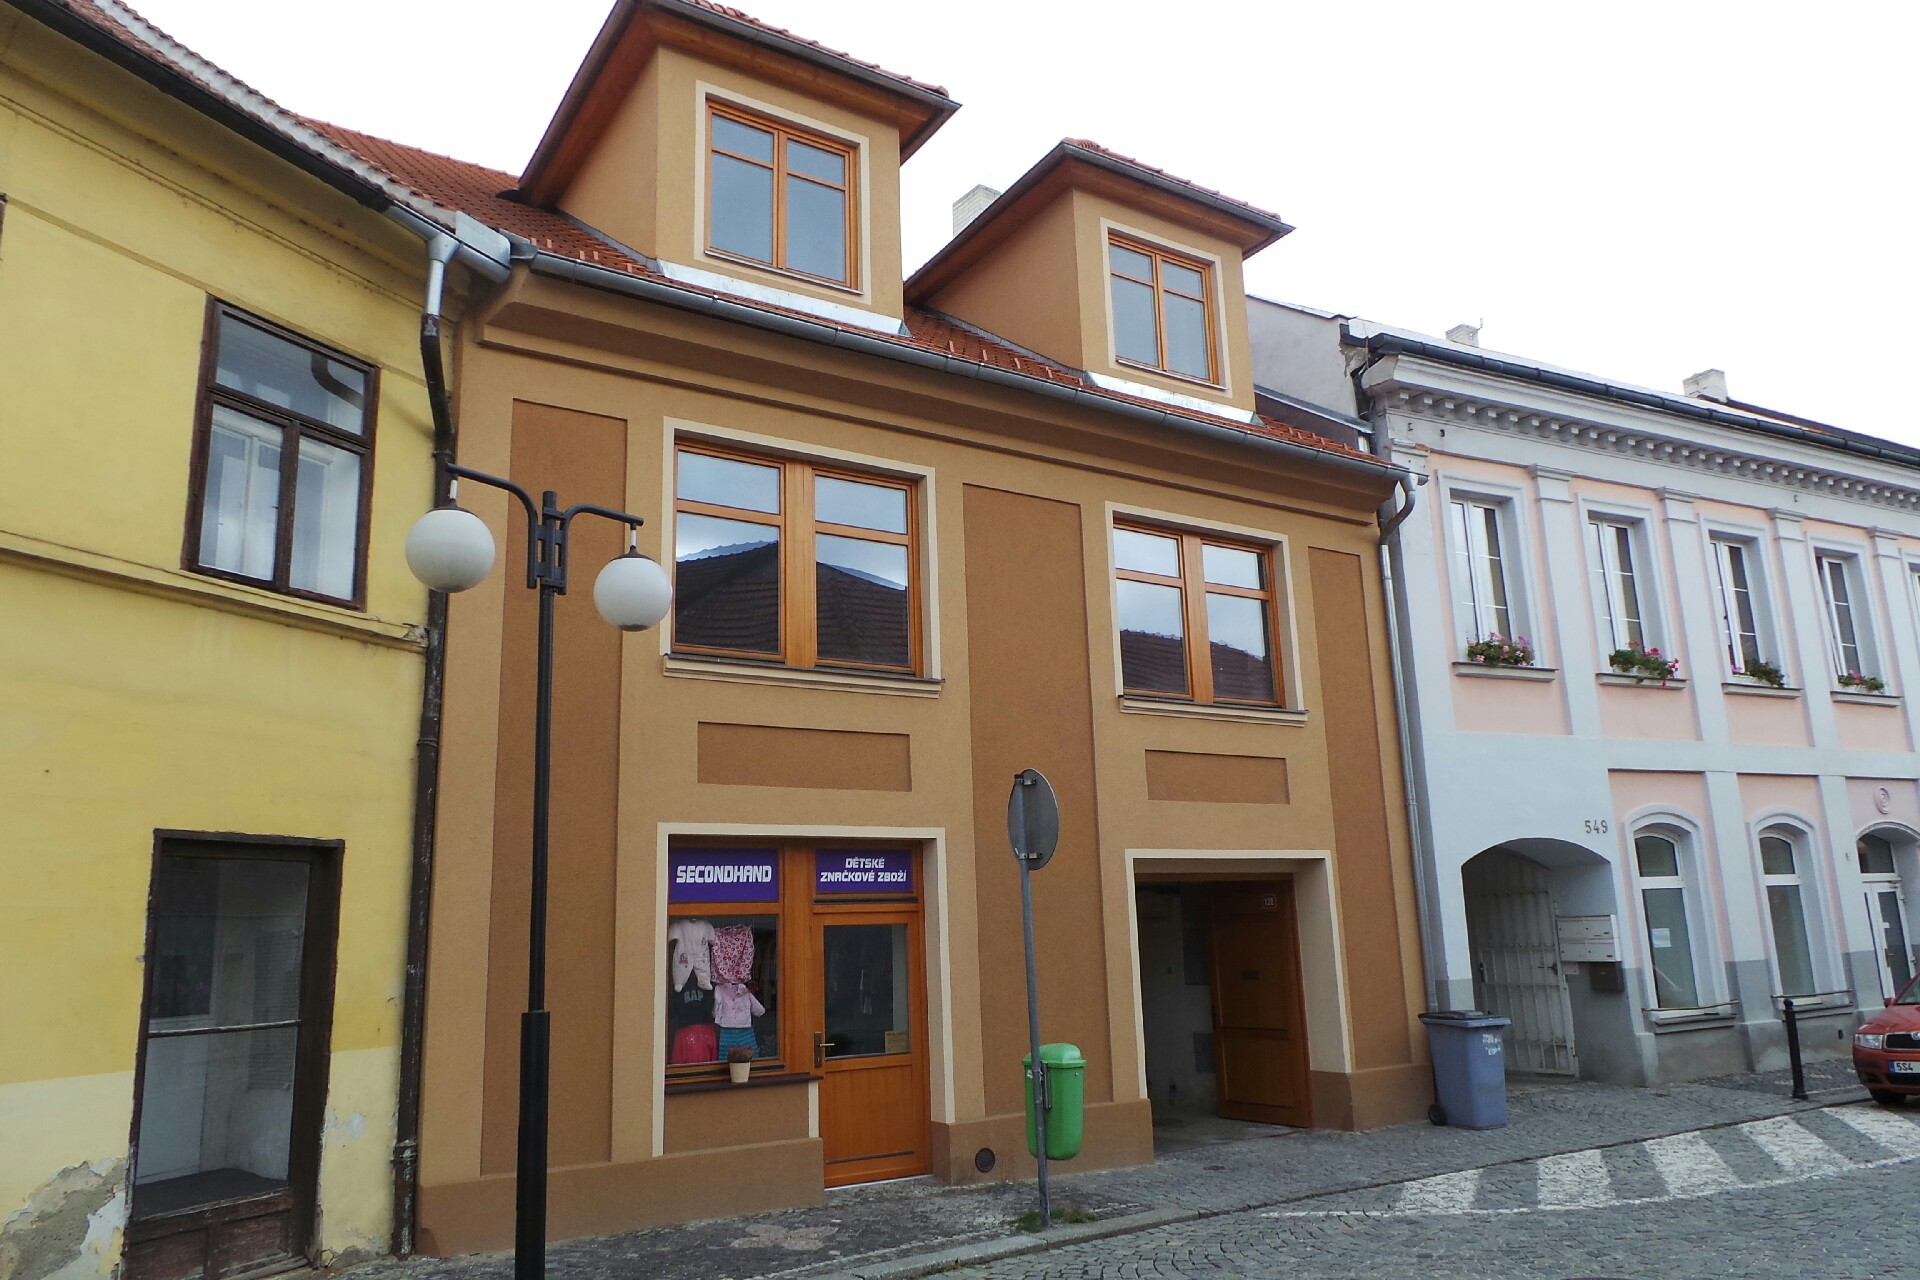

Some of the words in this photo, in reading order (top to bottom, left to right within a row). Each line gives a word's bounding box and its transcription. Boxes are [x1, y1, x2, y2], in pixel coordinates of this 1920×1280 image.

[1584, 819, 1608, 834] 549
[845, 856, 885, 869] DĚTSKÉ
[676, 865, 772, 883] SECONDHAND
[820, 870, 875, 882] ZNAČKOVÉ
[877, 870, 907, 882] ZBOŽÍ
[1896, 1062, 1913, 1072] 5S4
